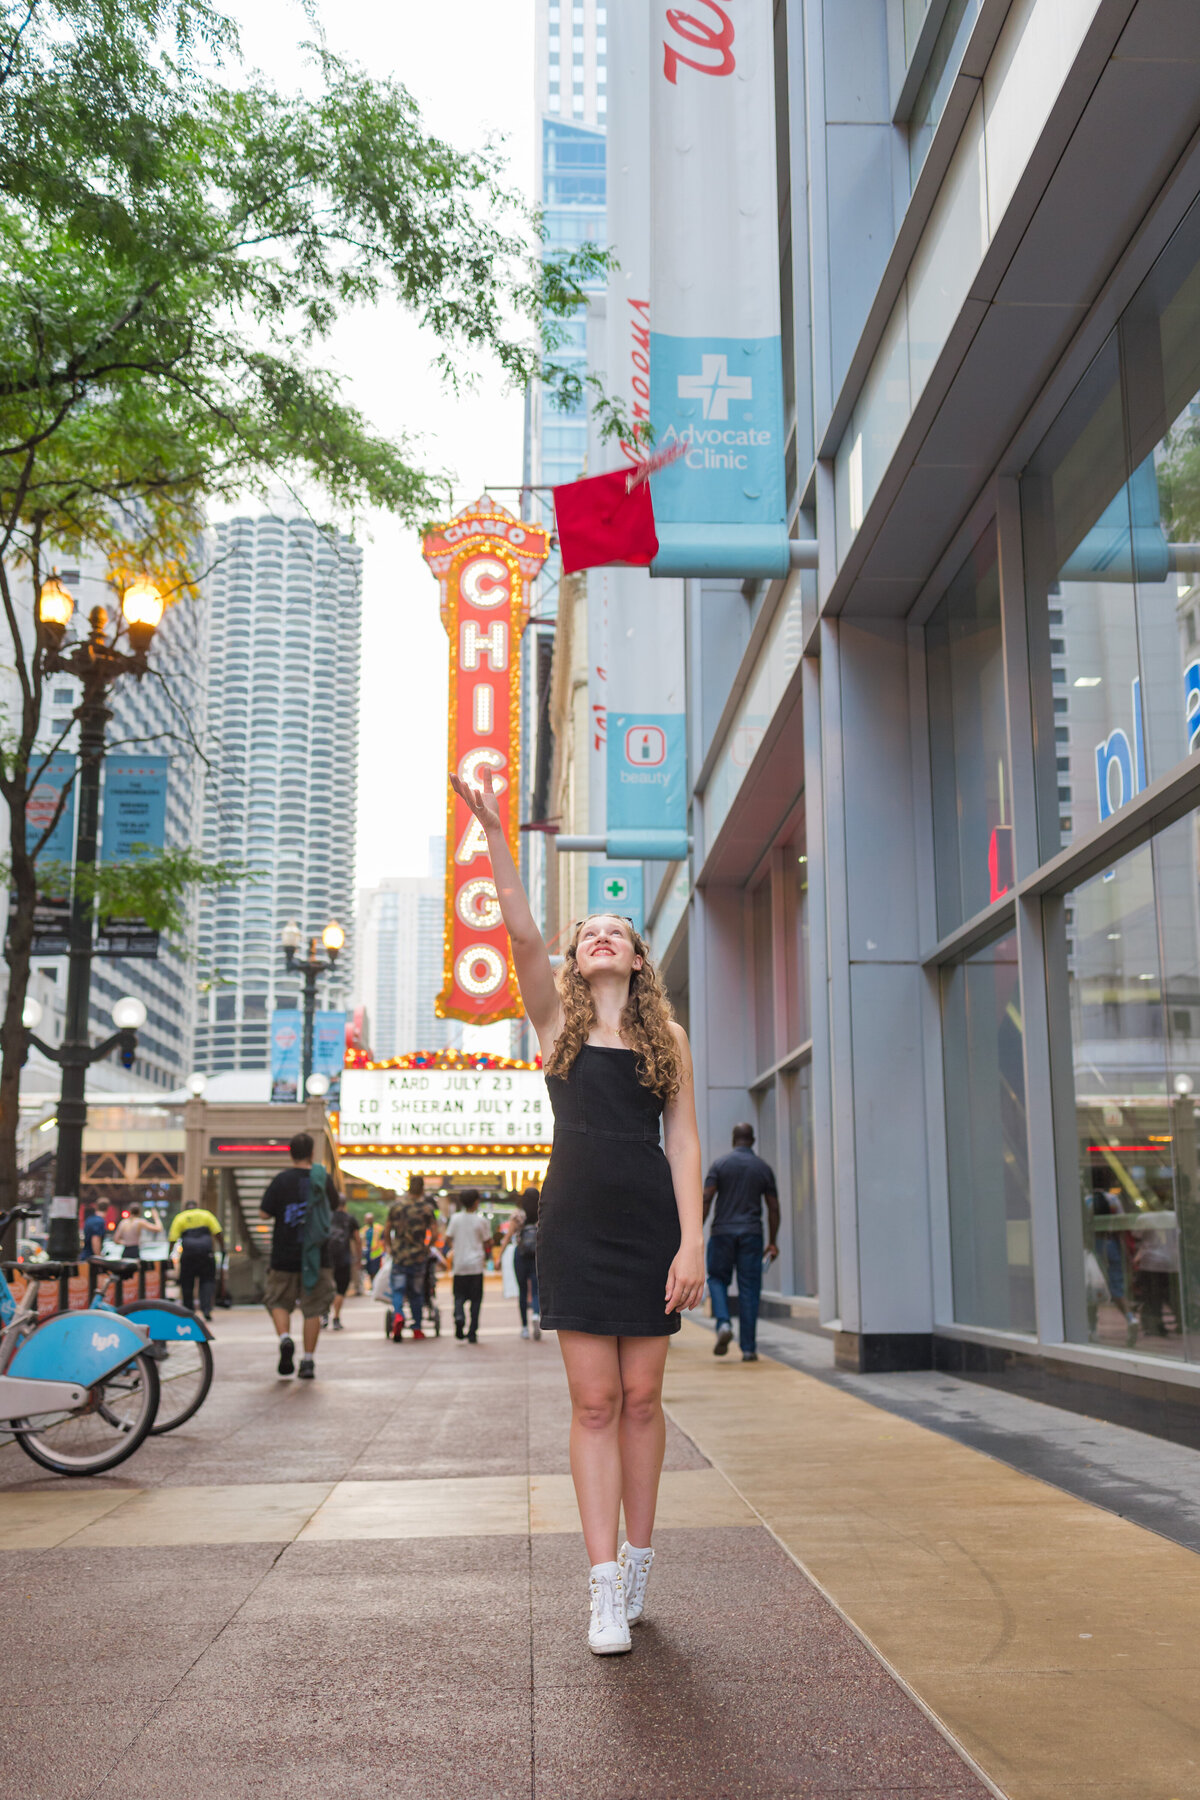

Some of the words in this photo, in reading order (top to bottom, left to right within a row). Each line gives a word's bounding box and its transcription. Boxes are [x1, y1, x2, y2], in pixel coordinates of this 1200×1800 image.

[662, 423, 771, 446] Advocate
[684, 448, 748, 470] Clinic
[444, 520, 508, 543] CHASE
[620, 769, 671, 787] beauty
[389, 1077, 429, 1090] KARD
[443, 1077, 482, 1091] JULY
[492, 1077, 513, 1090] 23
[359, 1100, 379, 1113] ED
[392, 1100, 464, 1113] SHEERAN
[474, 1100, 512, 1113] JULY
[521, 1100, 542, 1113] 28
[342, 1122, 382, 1136] TONY
[392, 1122, 495, 1136] HINCHCLIFFE
[91, 1332, 120, 1352] lyft
